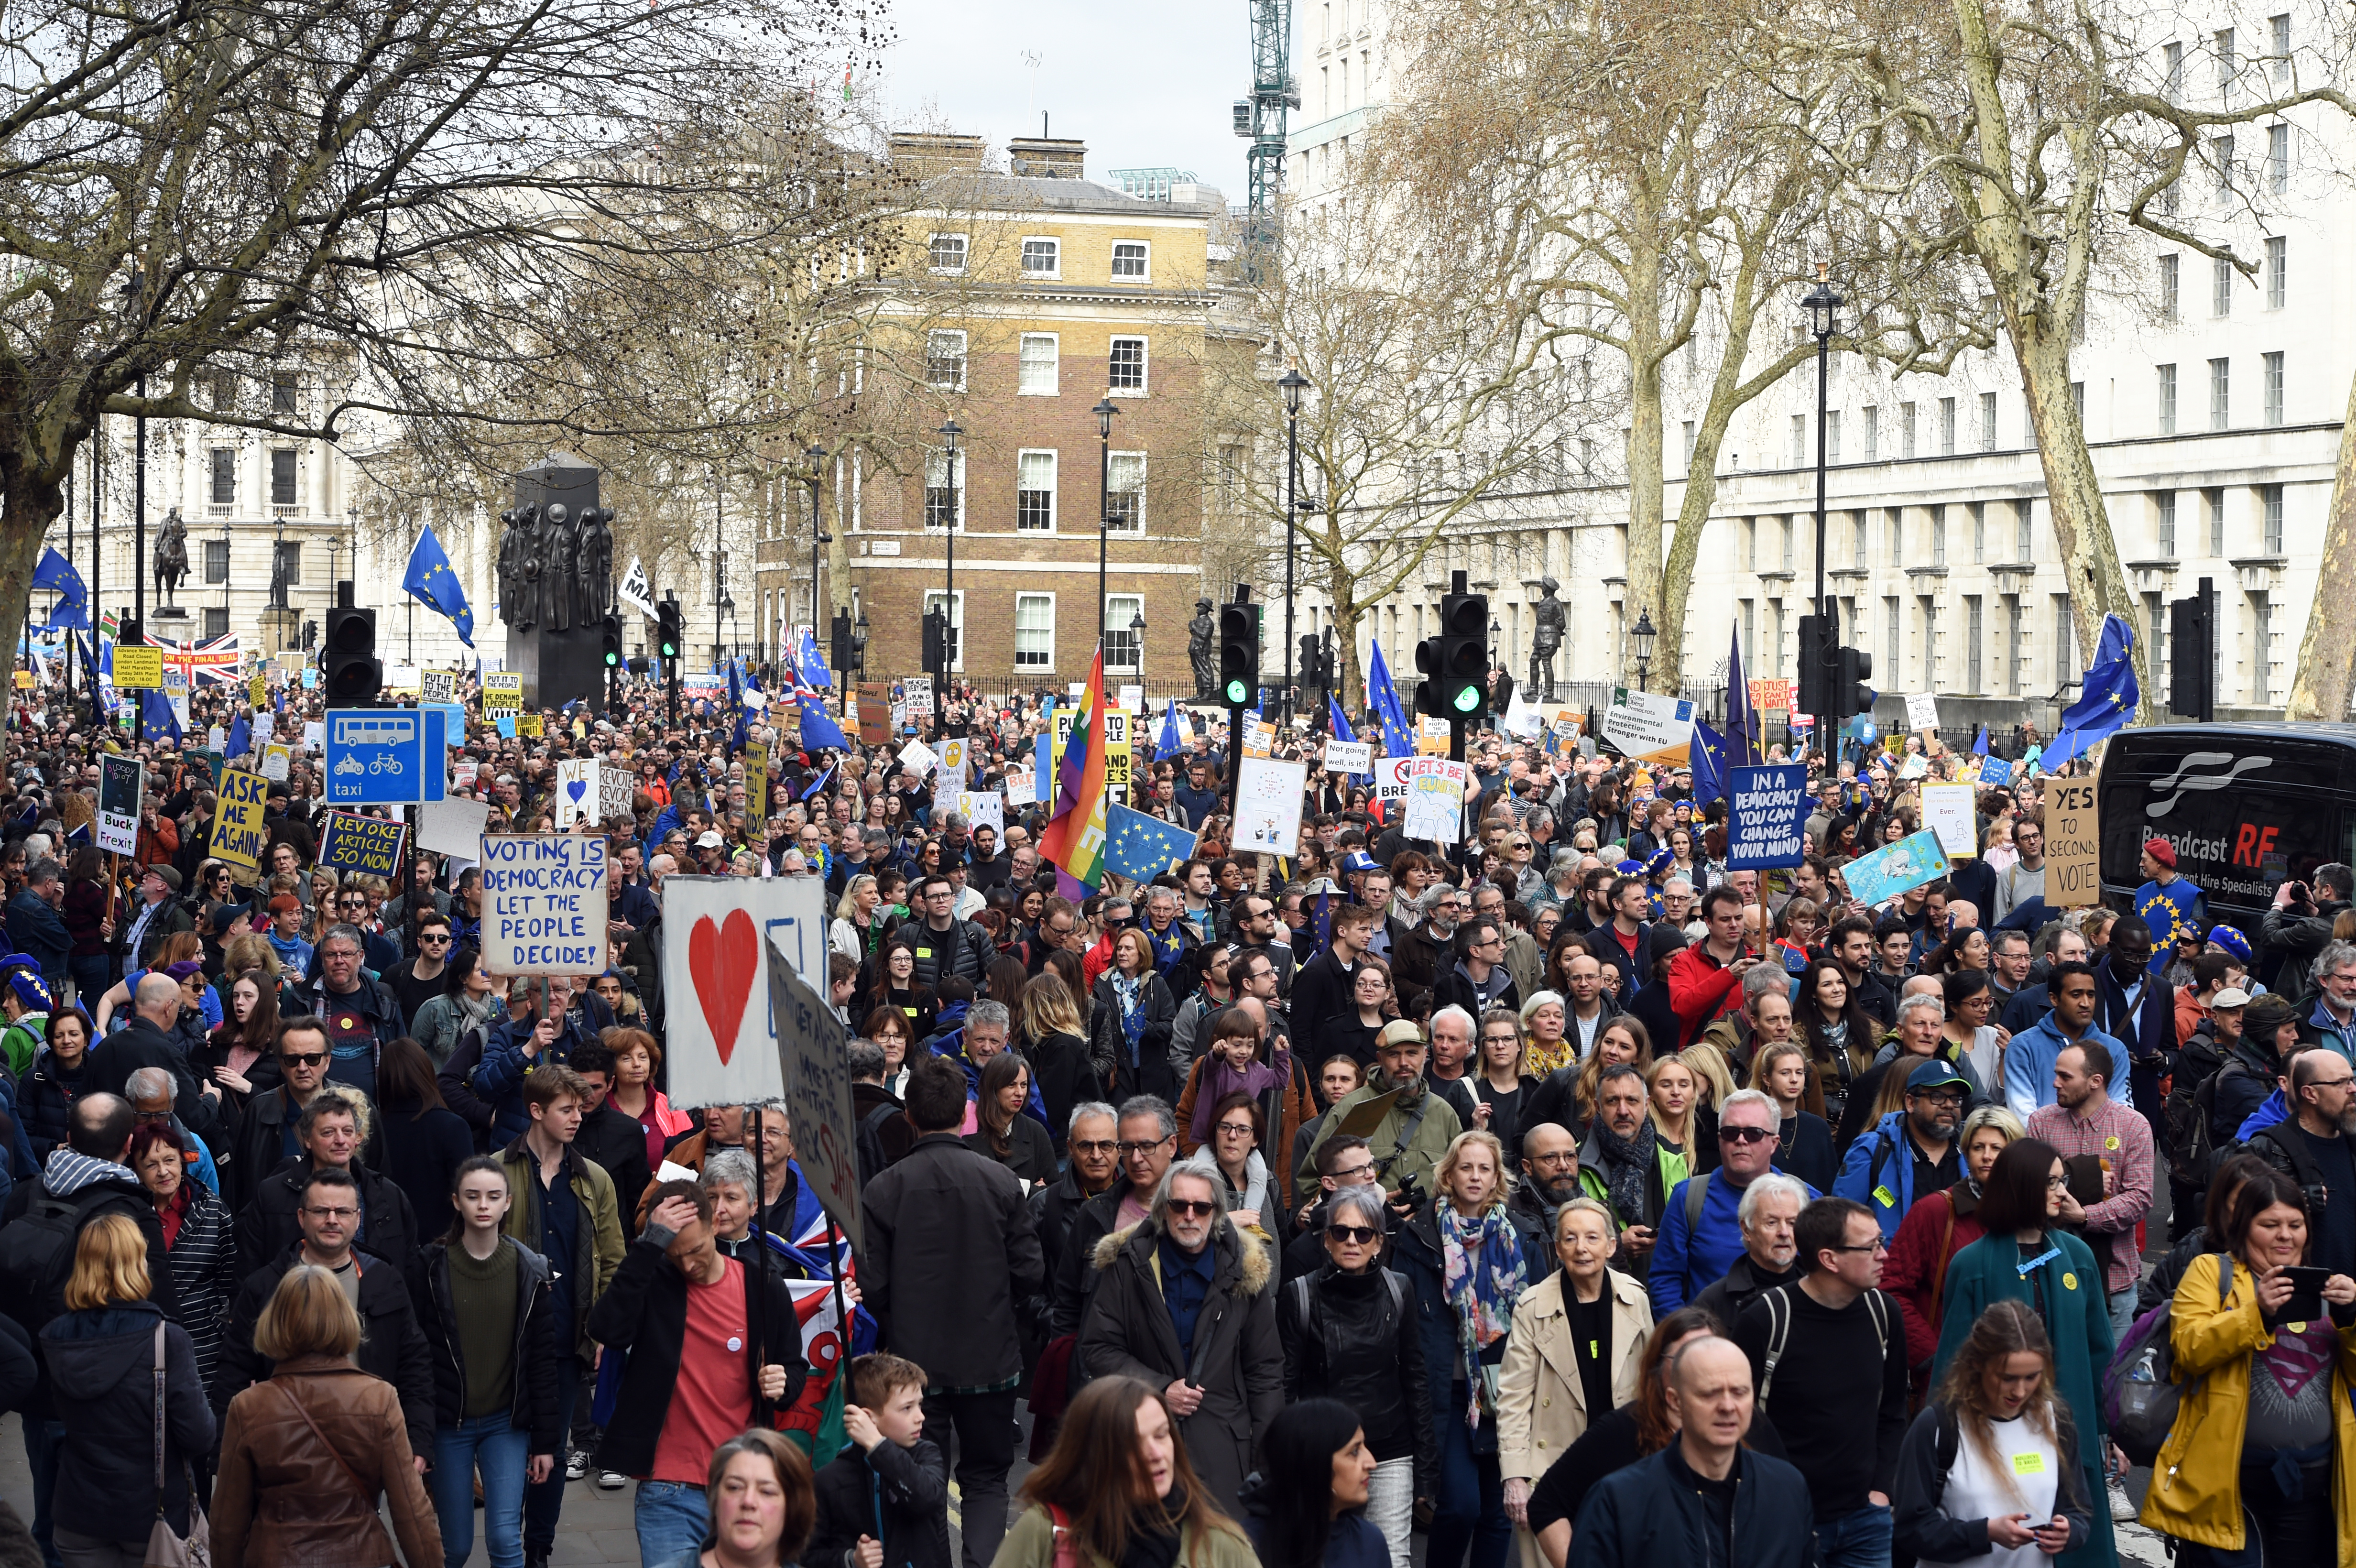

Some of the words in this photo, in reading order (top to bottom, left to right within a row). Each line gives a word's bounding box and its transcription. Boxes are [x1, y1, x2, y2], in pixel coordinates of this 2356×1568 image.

[218, 653, 237, 662] DEAL
[424, 681, 434, 689] TO
[436, 683, 451, 692] THE
[425, 673, 442, 683] PUT
[444, 675, 453, 684] IT
[1764, 681, 1789, 691] JUST
[423, 689, 451, 699] PEOPLE
[743, 689, 765, 708] WTF?
[1765, 697, 1789, 708] WAIT!
[485, 707, 519, 720] VOTE
[1626, 705, 1656, 715] Democrats
[517, 716, 539, 726] EUROPE
[1108, 717, 1123, 730] TO
[1608, 719, 1646, 732] Protection
[1610, 711, 1663, 728] Environmental
[519, 726, 538, 736] INNIT!
[863, 728, 888, 743] ROAR
[1607, 726, 1638, 739] Stronger
[1639, 734, 1656, 743] with
[1888, 735, 1905, 746] EUROPE
[746, 747, 762, 761] WHAT
[1329, 744, 1343, 752] Not
[1345, 747, 1366, 756] going
[107, 764, 136, 775] BLOODY
[562, 761, 589, 781] WE
[746, 762, 753, 772] DO
[754, 765, 763, 775] WE
[1328, 759, 1346, 767] well,
[1412, 760, 1444, 776] LET'S
[1448, 765, 1464, 780] BE
[939, 768, 960, 777] GROWN
[221, 773, 265, 806] ASK
[334, 782, 362, 796] taxi
[746, 775, 758, 794] TELL
[1753, 773, 1772, 791] IN
[1775, 772, 1786, 789] A
[600, 785, 632, 805] REVOKE
[746, 794, 755, 808] THE
[935, 790, 949, 800] SORT
[1735, 788, 1802, 810] DEMOCRACY
[2055, 787, 2094, 810] YES
[222, 804, 248, 825] ME
[600, 801, 631, 817] REMAIN
[1738, 809, 1767, 826] YOU
[1767, 807, 1796, 823] CAN
[105, 814, 133, 831] Buck
[334, 817, 401, 839] REVOKE
[746, 809, 764, 836] KIDS?
[2061, 818, 2077, 834] TO
[100, 831, 132, 849] Frexit
[1741, 824, 1792, 841] CHANGE
[212, 824, 260, 859] AGAIN
[335, 834, 393, 853] ARTICLE
[1732, 842, 1764, 859] YOUR
[1765, 837, 1800, 857] MIND
[2050, 839, 2095, 857] SECOND
[2233, 823, 2280, 869] RF
[331, 847, 359, 864] 50
[360, 852, 393, 871] NOW
[581, 840, 604, 862] IS
[2057, 862, 2096, 893] VOTE
[2201, 874, 2219, 890] Hire
[2222, 877, 2272, 898] Specialists
[496, 896, 536, 915] LET
[543, 894, 580, 912] THE
[501, 916, 586, 940] PEOPLE
[513, 945, 596, 966] DECIDE!
[820, 1123, 855, 1221] SHIT
